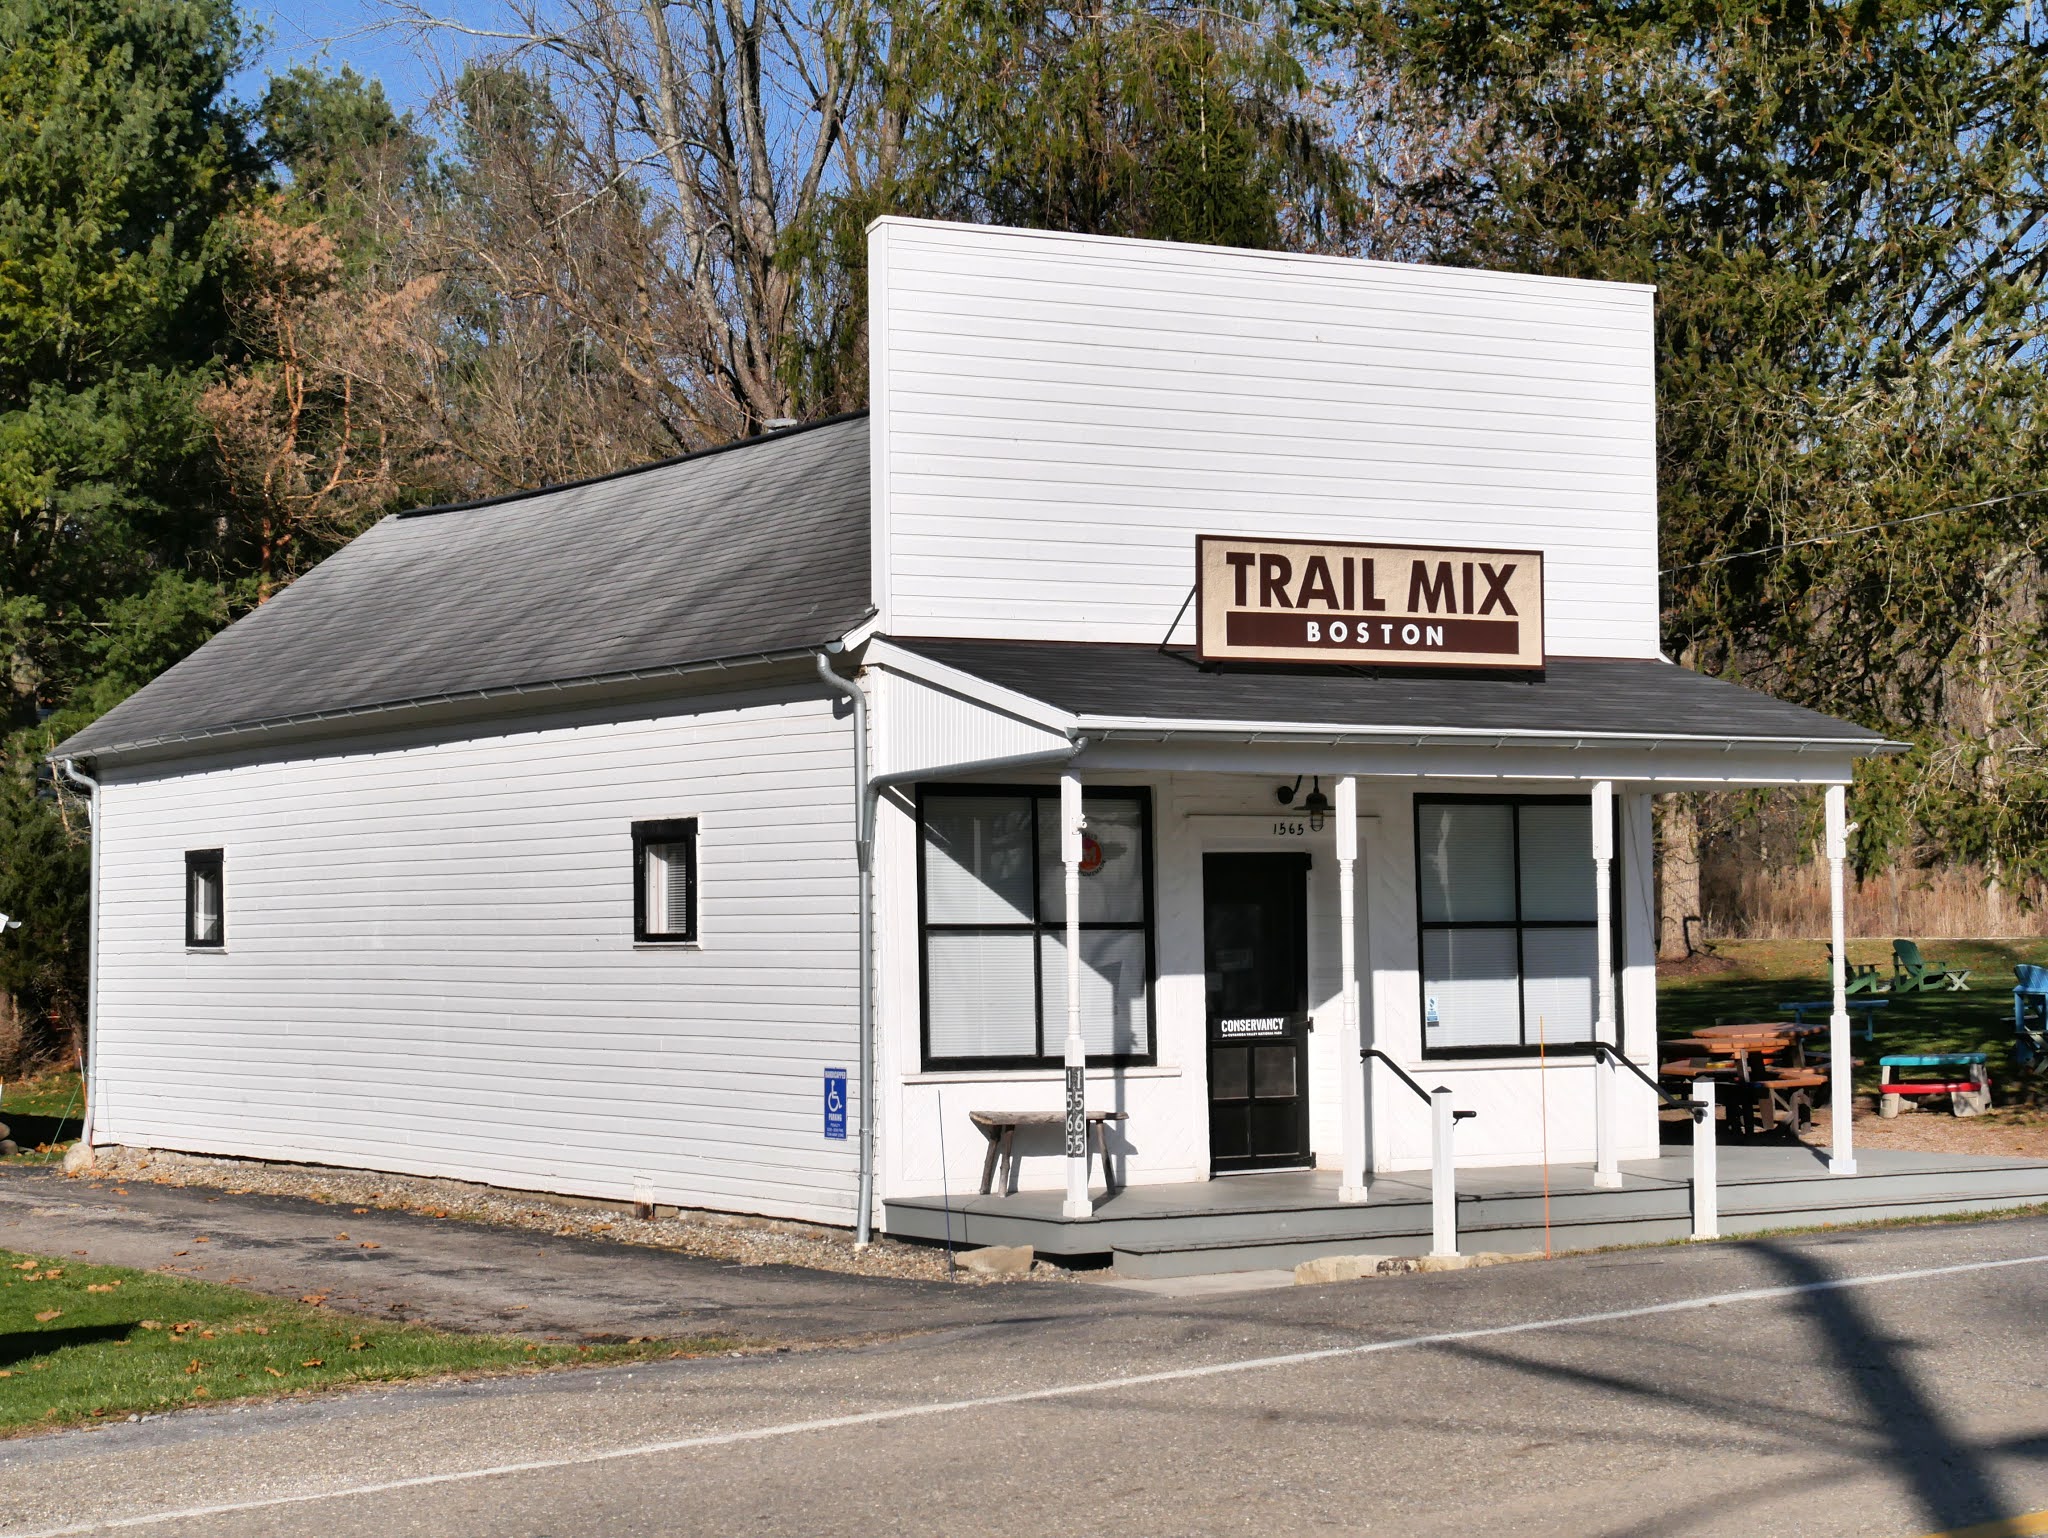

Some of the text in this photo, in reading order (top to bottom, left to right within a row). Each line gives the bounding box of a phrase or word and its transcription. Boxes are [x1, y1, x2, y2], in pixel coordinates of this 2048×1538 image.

[1226, 551, 1519, 616] TRAIL MIX
[1307, 621, 1444, 646] BOSTON
[1273, 822, 1304, 835] 1565
[1222, 1018, 1284, 1032] CONSERVANCY
[1075, 1070, 1084, 1154] 1565
